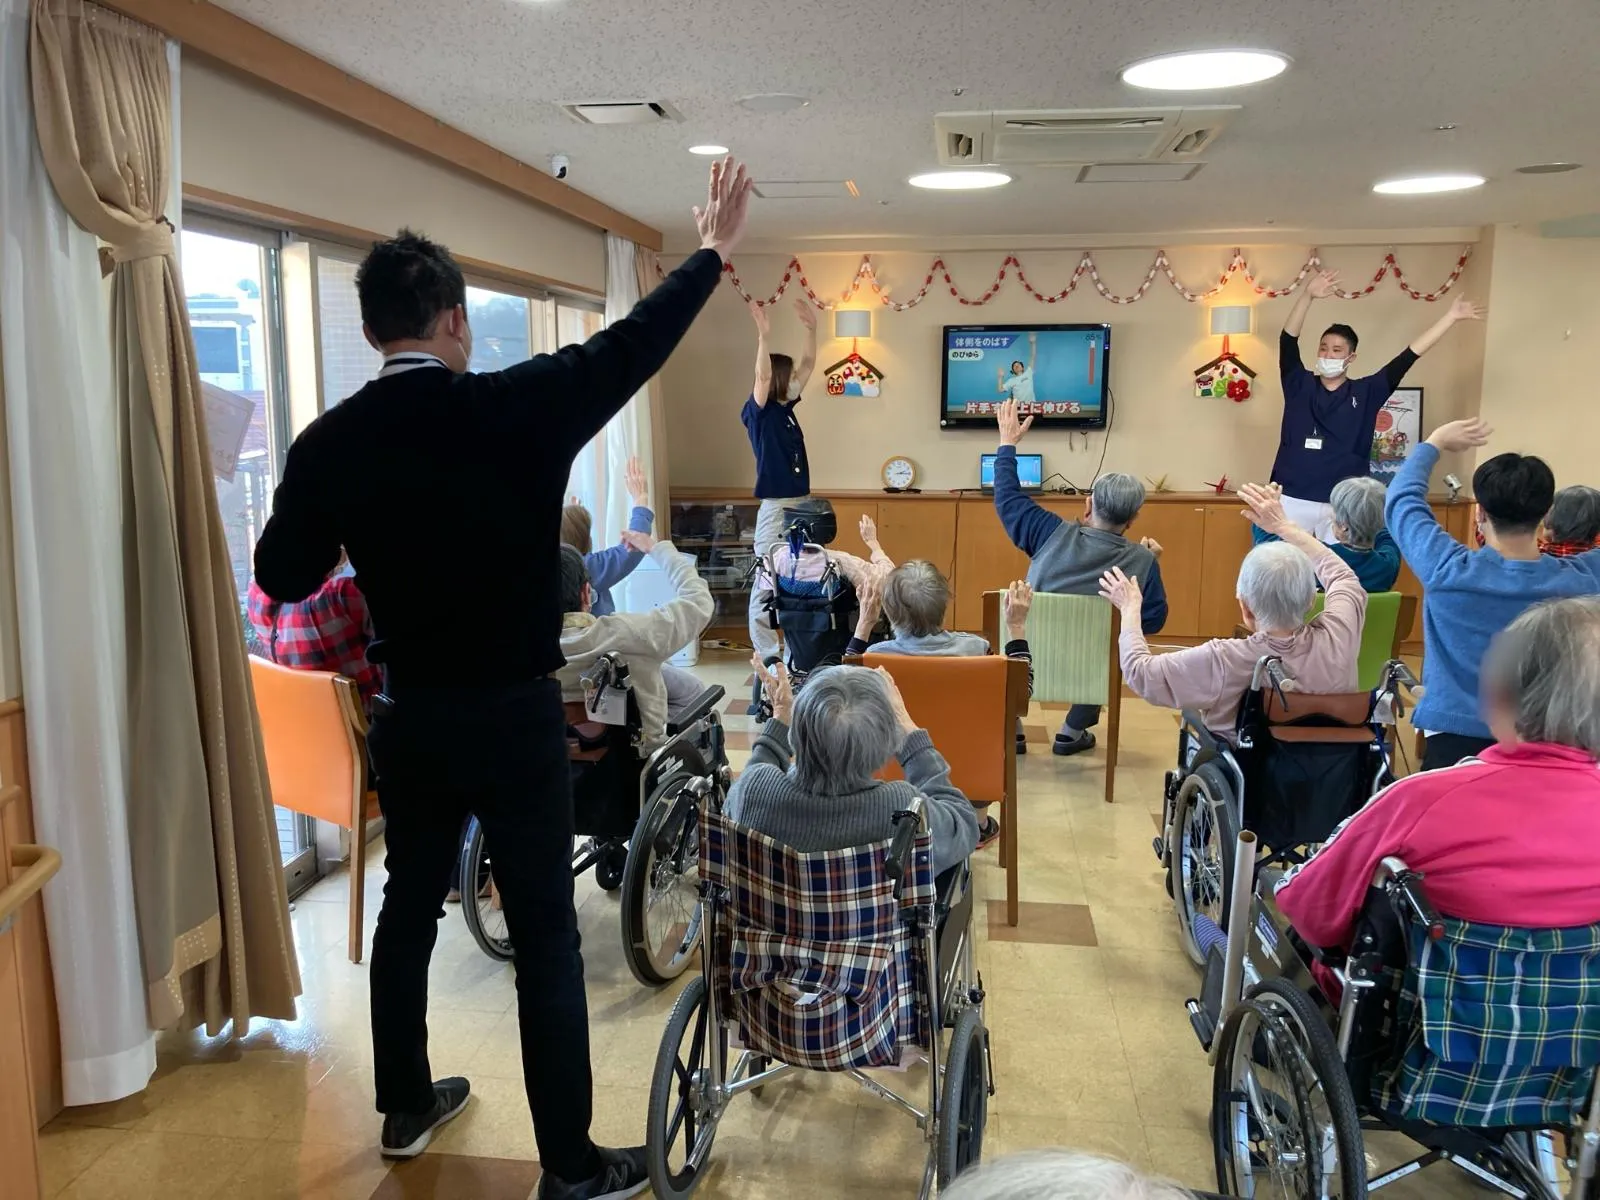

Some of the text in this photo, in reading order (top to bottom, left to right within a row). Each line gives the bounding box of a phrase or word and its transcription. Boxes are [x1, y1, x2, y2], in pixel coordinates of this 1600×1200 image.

[965, 402, 1081, 414] 片手上に伸びる
